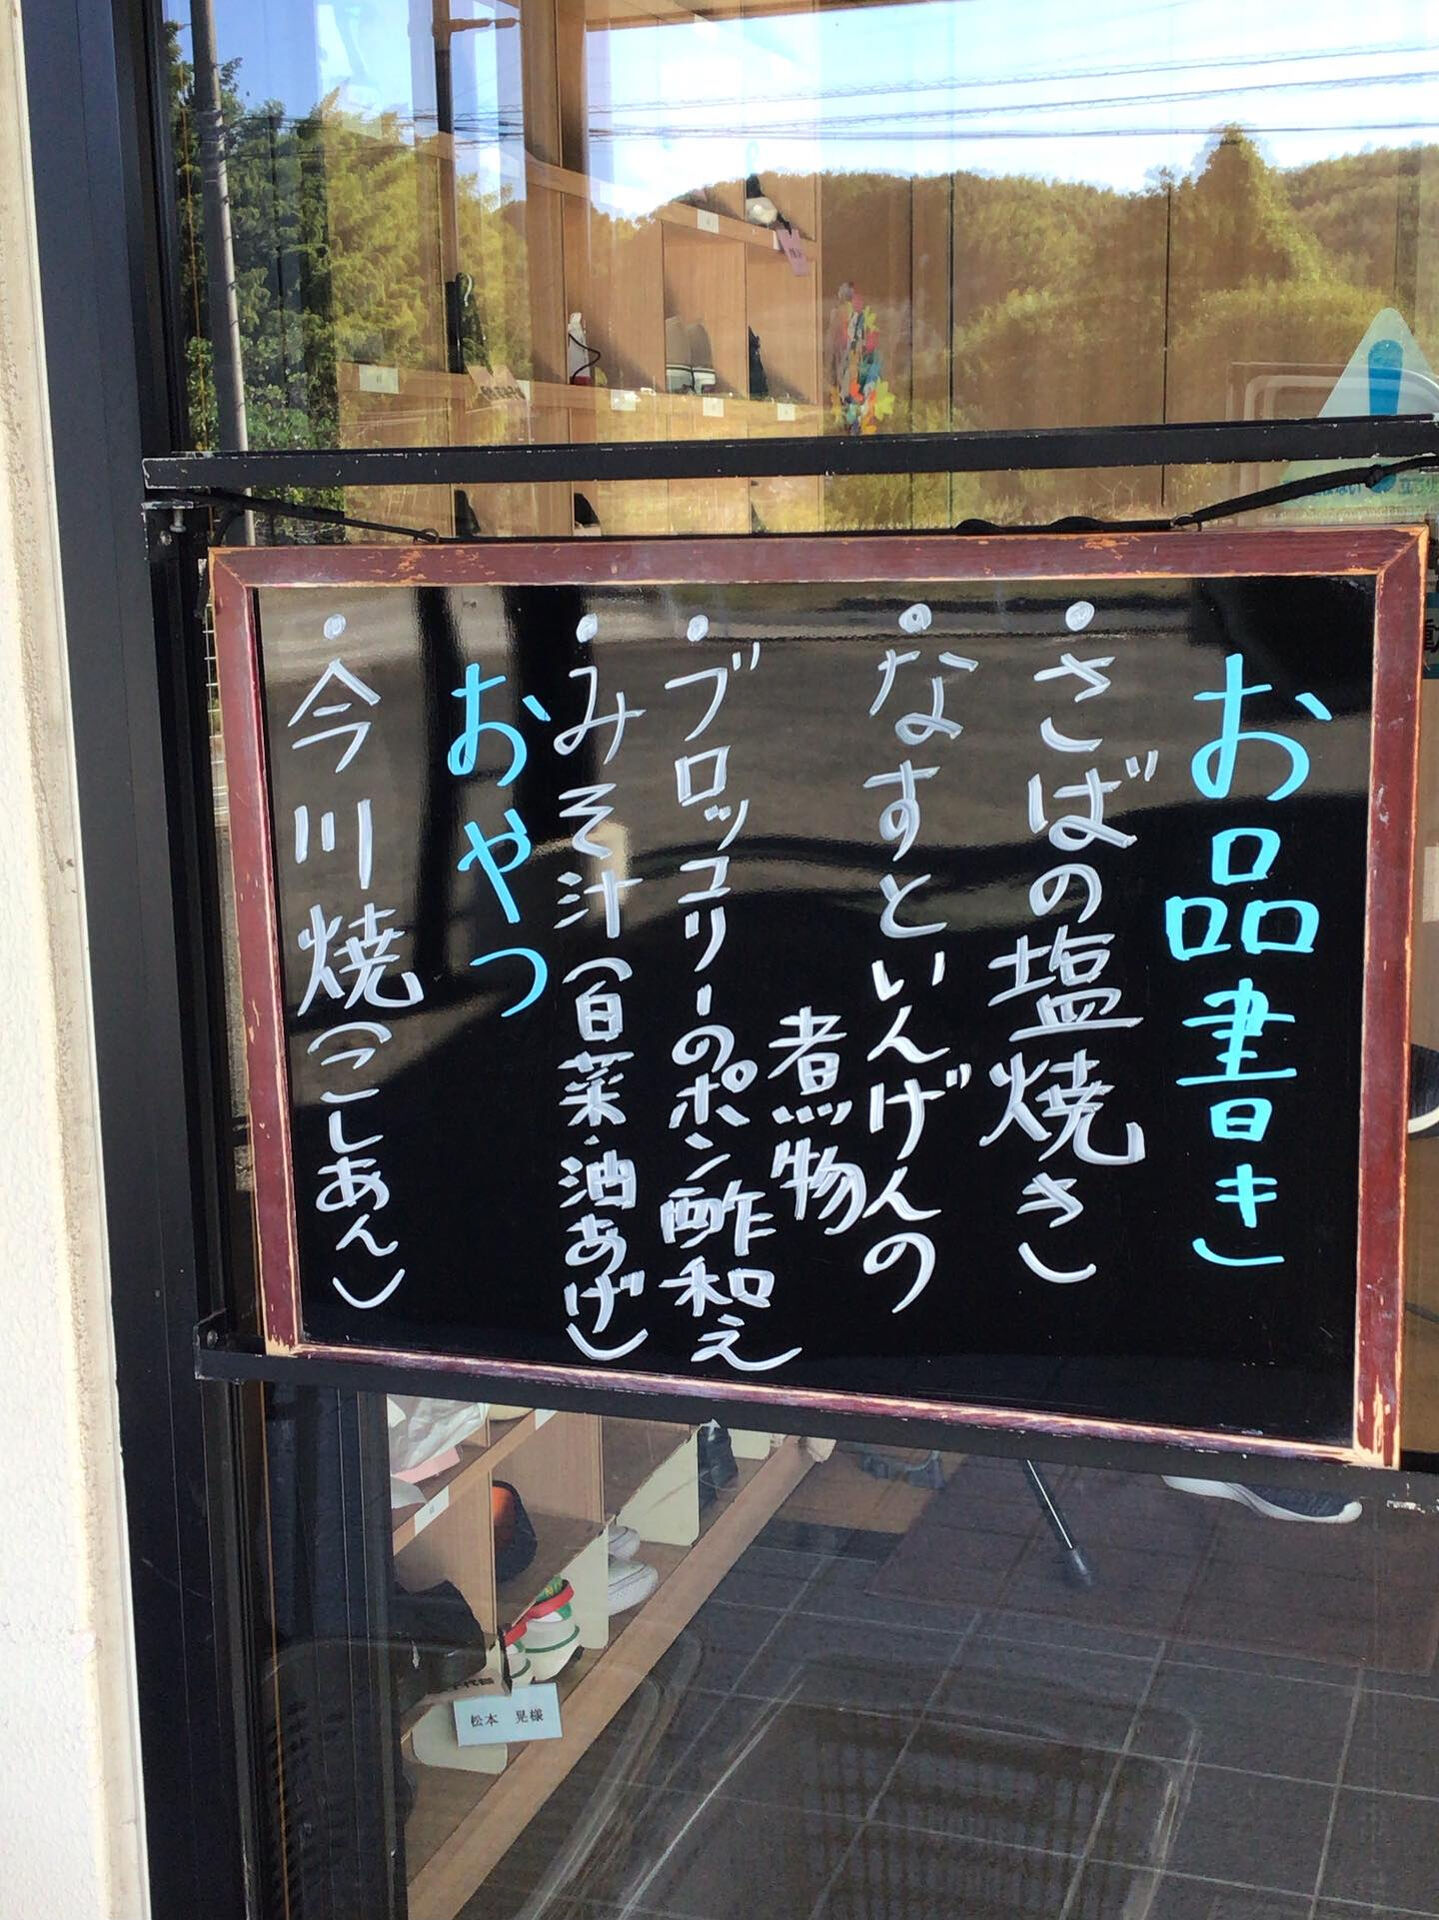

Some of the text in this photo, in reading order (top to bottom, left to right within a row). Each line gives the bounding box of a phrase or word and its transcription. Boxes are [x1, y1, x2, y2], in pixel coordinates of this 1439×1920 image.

[447, 662, 552, 1018] おやつ
[1164, 652, 1333, 1269] お品書き
[768, 1006, 867, 1236] 煮物
